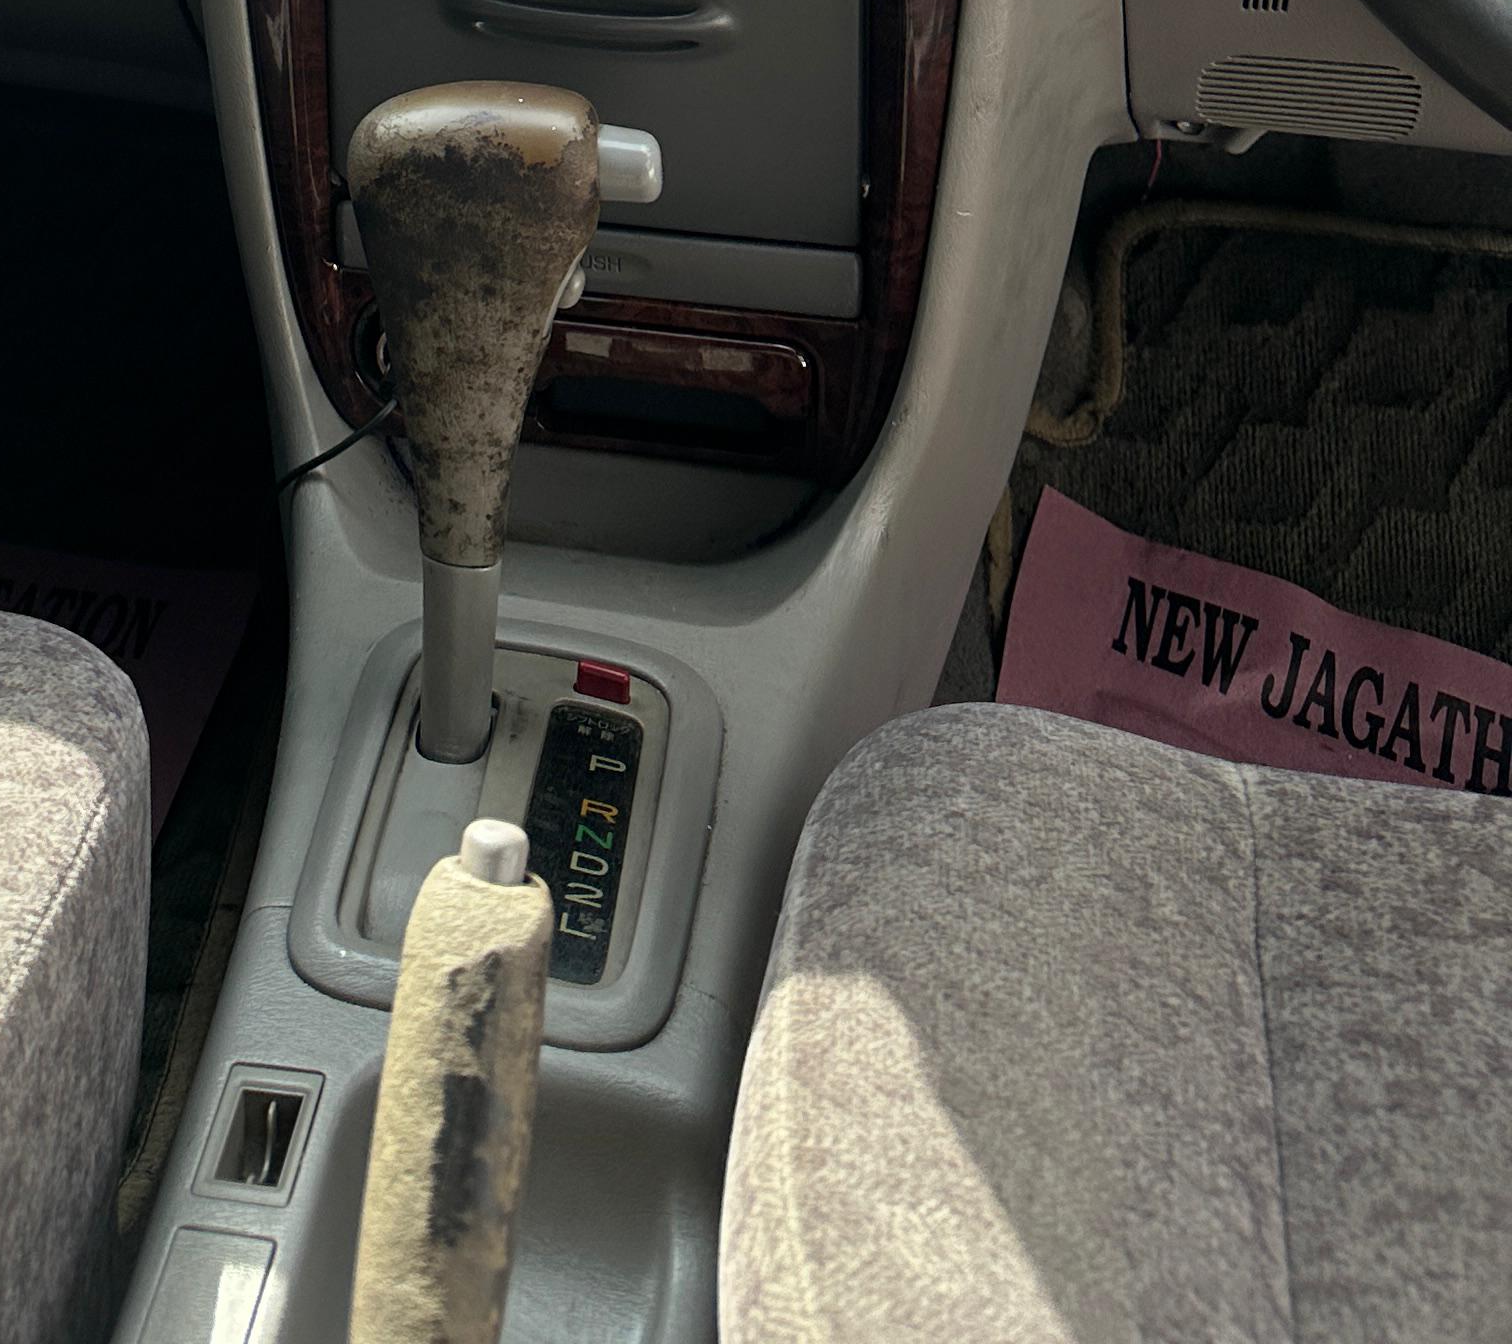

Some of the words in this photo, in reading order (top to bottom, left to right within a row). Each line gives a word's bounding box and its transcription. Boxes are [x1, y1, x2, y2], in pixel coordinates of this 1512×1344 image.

[580, 254, 621, 272] USH
[1111, 576, 1259, 696] NEW
[1260, 631, 1512, 797] JAGATH
[589, 754, 627, 773] P
[579, 797, 620, 825] R
[574, 823, 614, 850] N
[569, 850, 610, 877] D
[564, 881, 605, 909] 2
[559, 911, 598, 941] L
